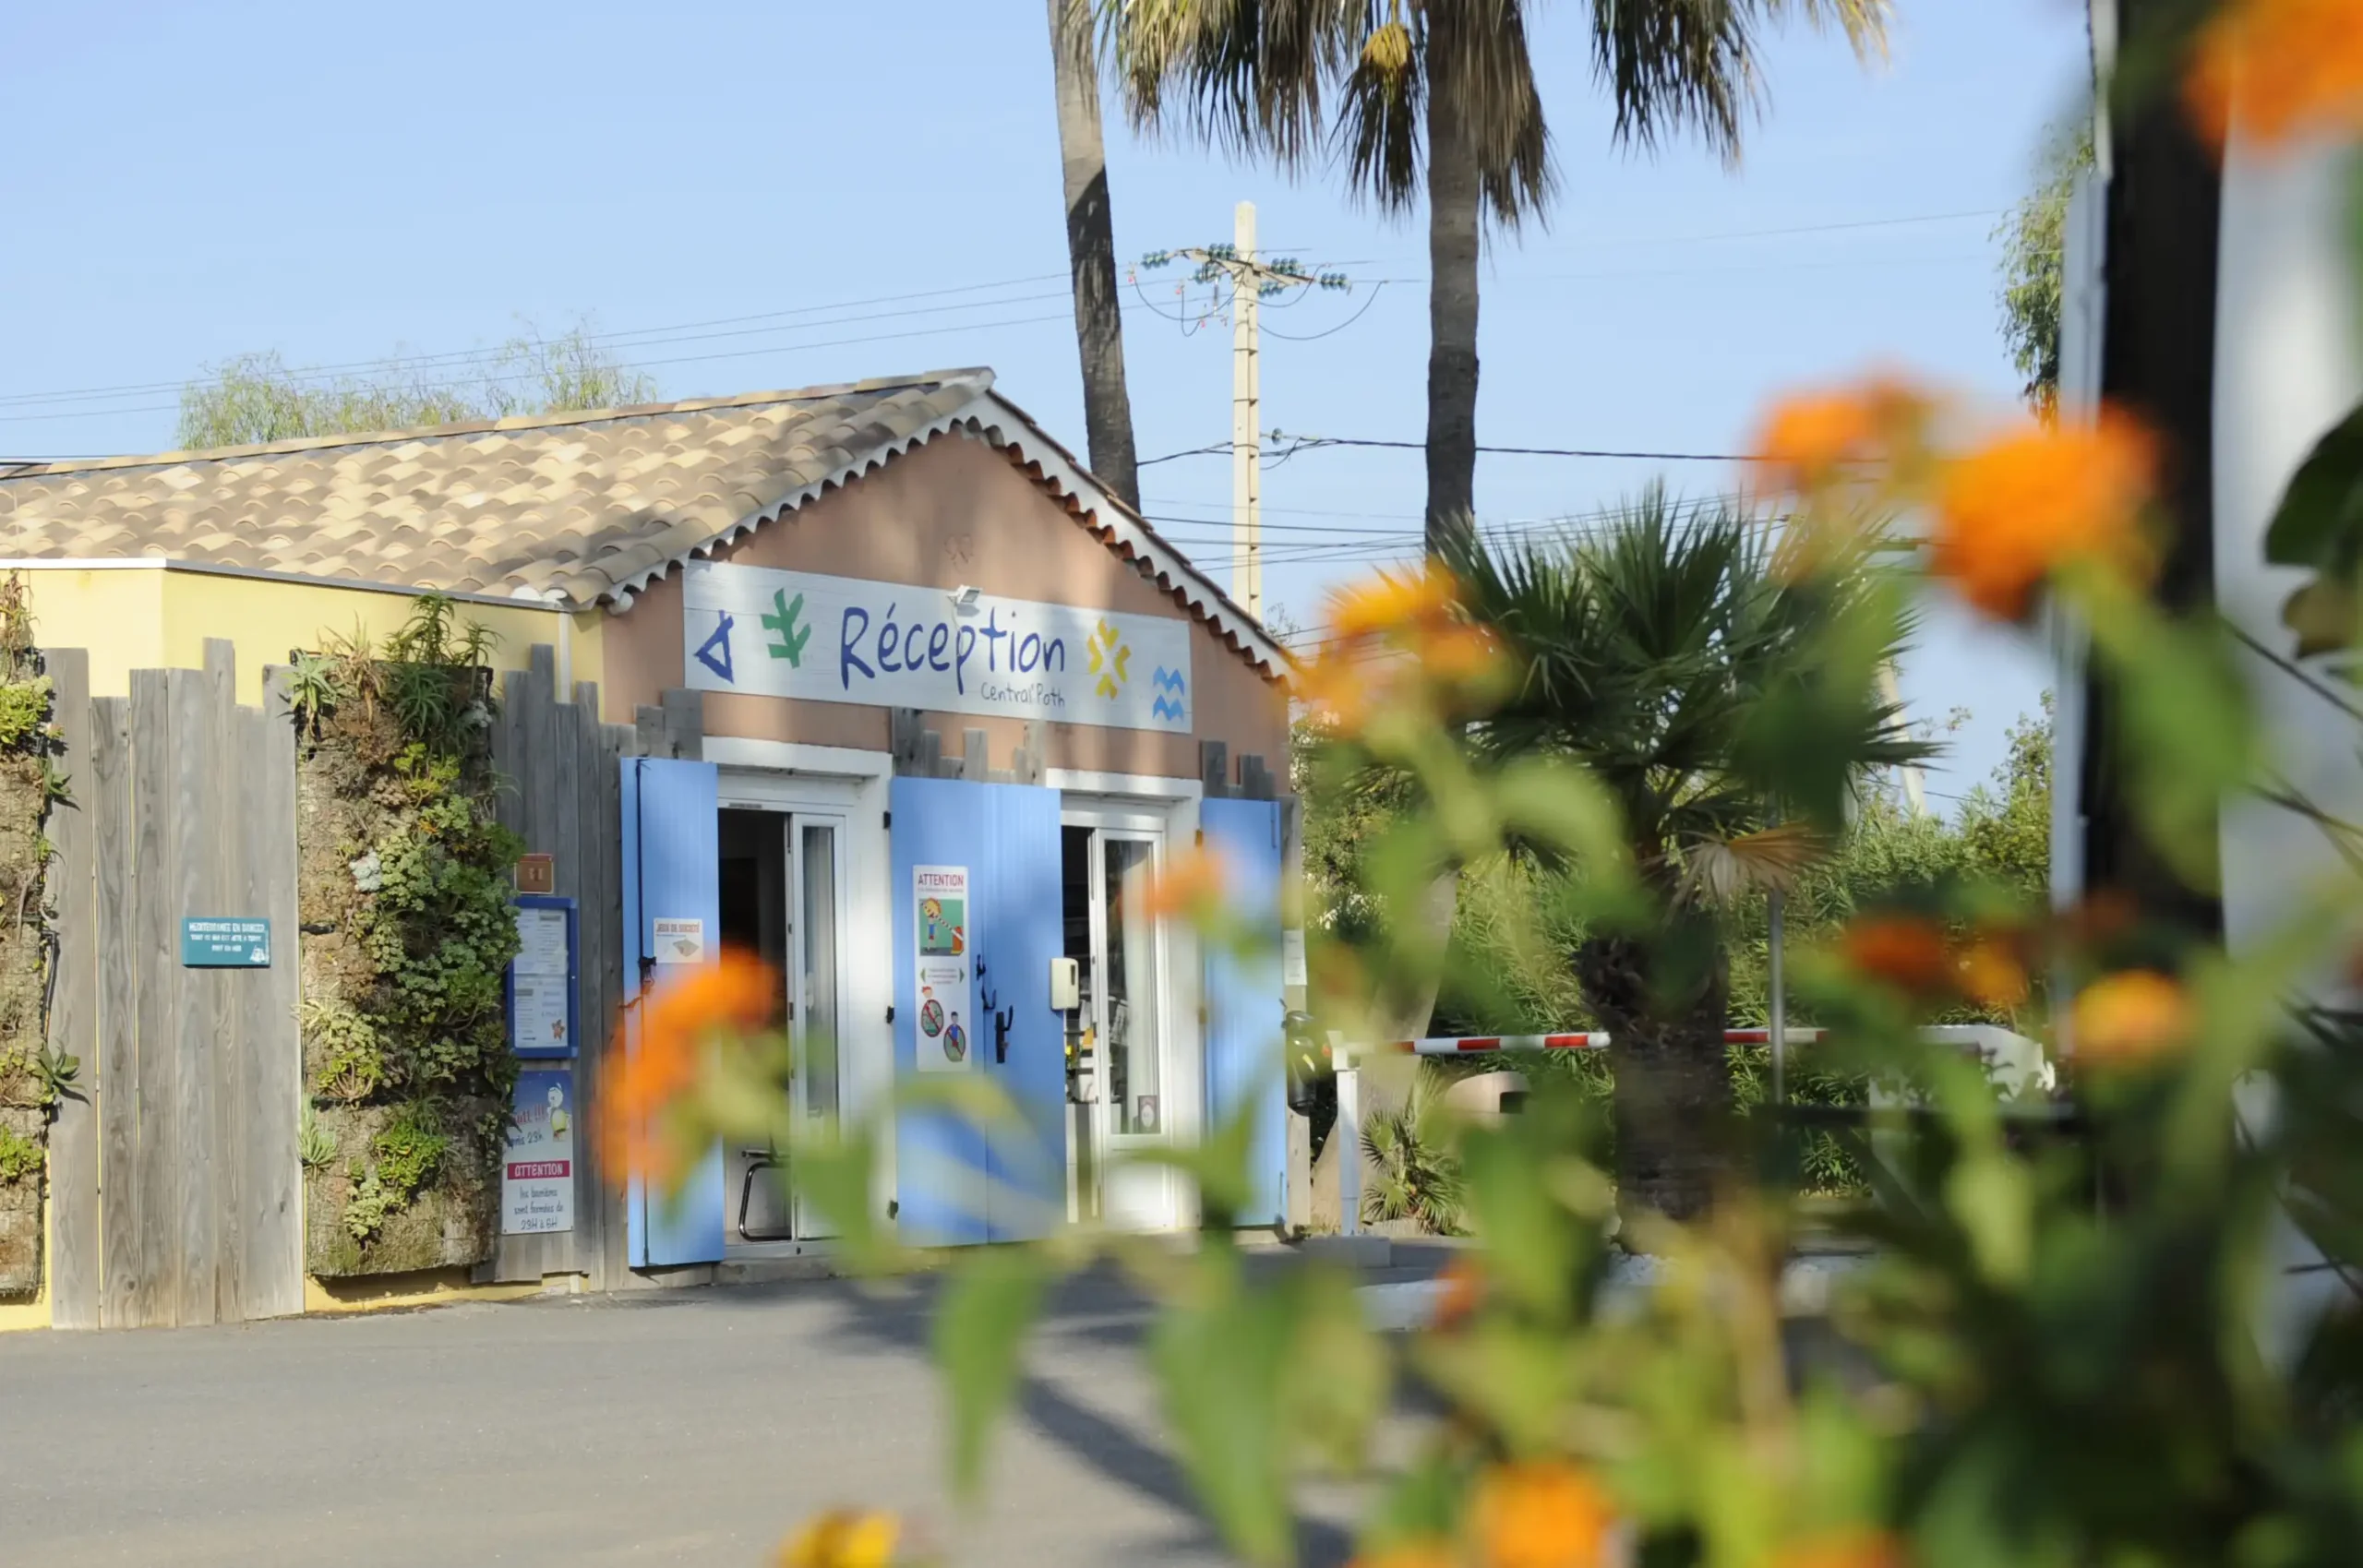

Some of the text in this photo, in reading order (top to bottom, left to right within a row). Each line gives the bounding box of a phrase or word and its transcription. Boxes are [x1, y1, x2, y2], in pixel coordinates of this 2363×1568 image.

[841, 602, 1065, 696] Réception
[918, 873, 964, 887] ATTENTION
[514, 1163, 564, 1178] ATTENTION
